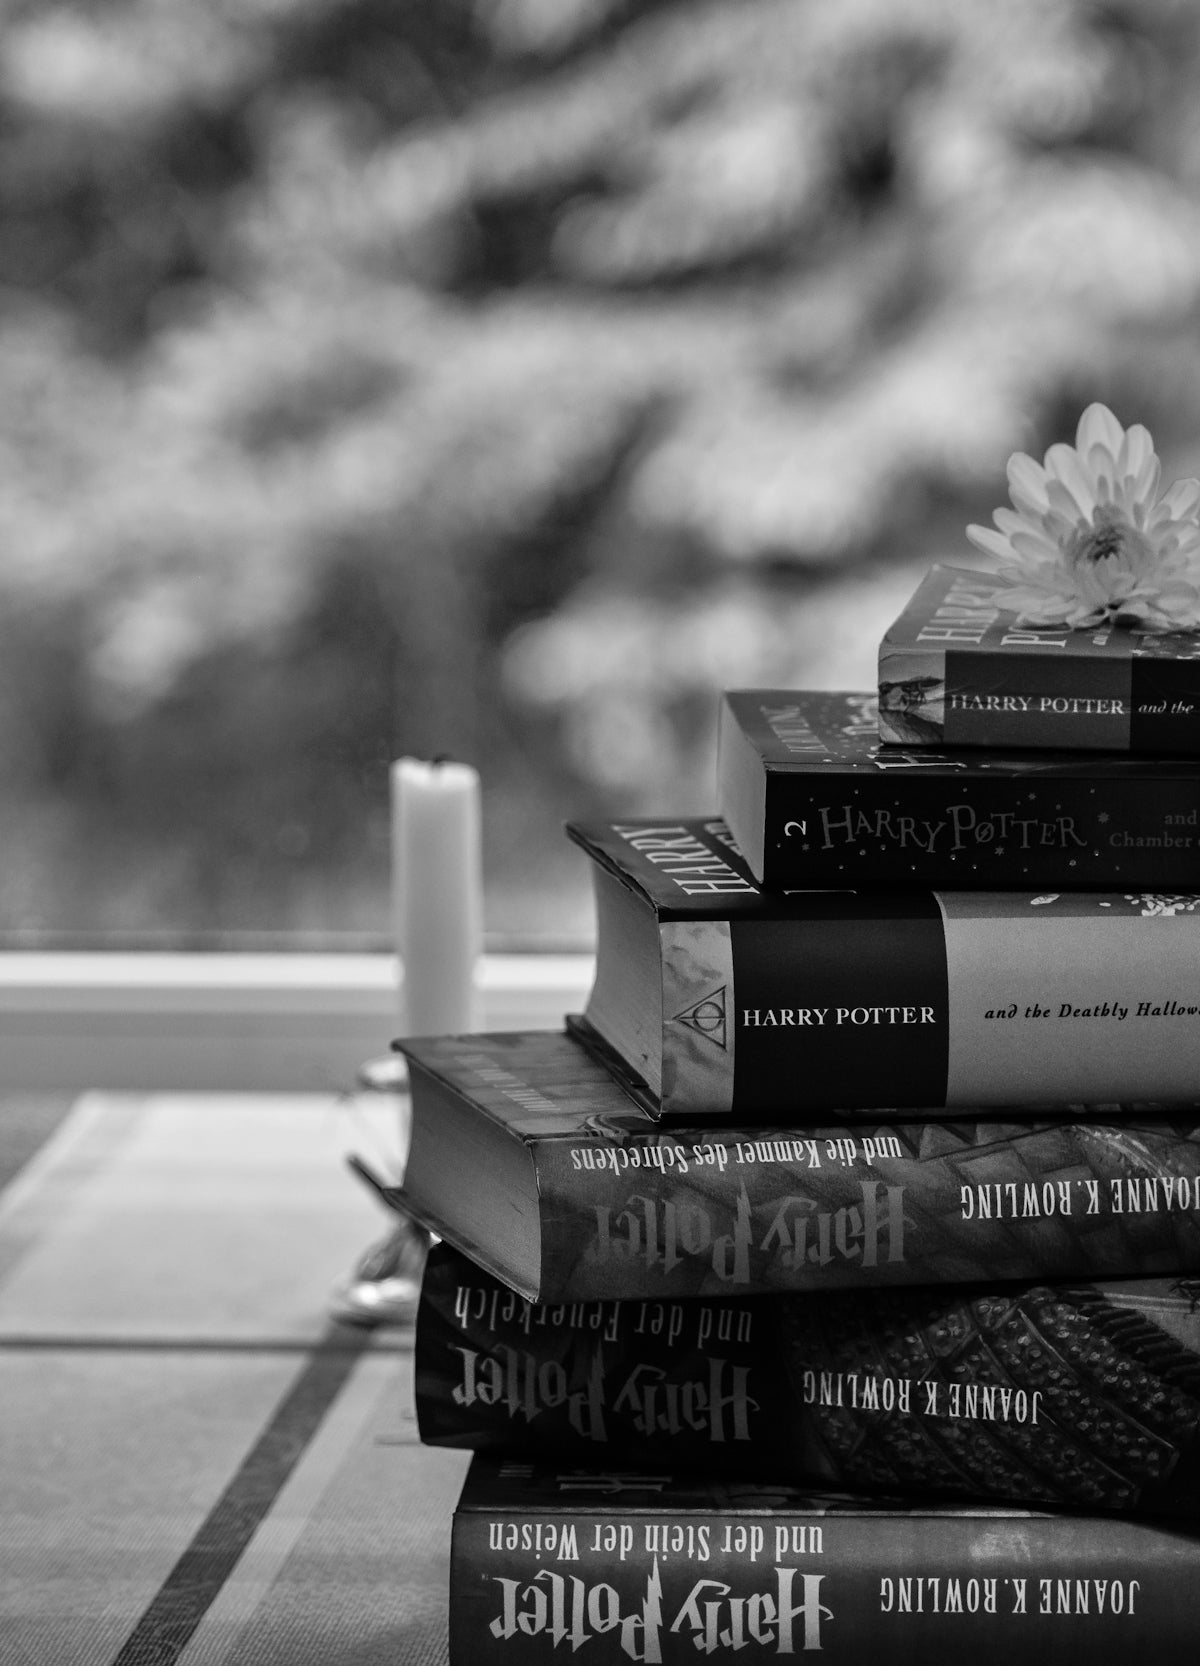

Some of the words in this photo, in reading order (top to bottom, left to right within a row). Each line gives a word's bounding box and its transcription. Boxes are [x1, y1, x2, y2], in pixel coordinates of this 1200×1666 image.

[951, 694, 1032, 712] HARRY
[1039, 697, 1125, 715] POTTER
[1138, 701, 1167, 714] and
[1170, 701, 1195, 715] the
[784, 819, 807, 837] 2
[818, 804, 946, 853] HARRY
[946, 804, 1088, 850] POTTER
[1164, 809, 1198, 825] and
[1109, 831, 1193, 848] Chamber
[611, 824, 761, 895] HARRY
[743, 1008, 828, 1027] HARRY
[836, 1006, 937, 1026] POTTER
[984, 1004, 1018, 1020] and
[1024, 1003, 1051, 1019] the
[1058, 1002, 1128, 1020] Deathly
[570, 1145, 686, 1176] Schreckens
[692, 1143, 728, 1172] des
[735, 1139, 822, 1168] Kammer
[825, 1137, 857, 1167] die
[862, 1136, 903, 1165] und
[960, 1180, 1073, 1220] ROWLING
[1111, 1175, 1200, 1214] JOANNE
[584, 1175, 753, 1284] Potter
[760, 1180, 918, 1268] Harry
[634, 1302, 684, 1347] der
[697, 1307, 752, 1349] und
[450, 1342, 609, 1443] Potter
[612, 1356, 761, 1443] Harry
[803, 1370, 912, 1414] ROWLING
[949, 1382, 1044, 1425] JOANNE
[488, 1522, 580, 1561] Weisen
[590, 1524, 634, 1561] der
[645, 1524, 711, 1562] Stein
[721, 1525, 765, 1562] der
[775, 1525, 824, 1562] und
[488, 1551, 663, 1664] Potter
[669, 1567, 834, 1655] Harry
[879, 1577, 998, 1614] ROWLING
[1004, 1578, 1028, 1614] K.
[1039, 1578, 1140, 1615] JOANNE
